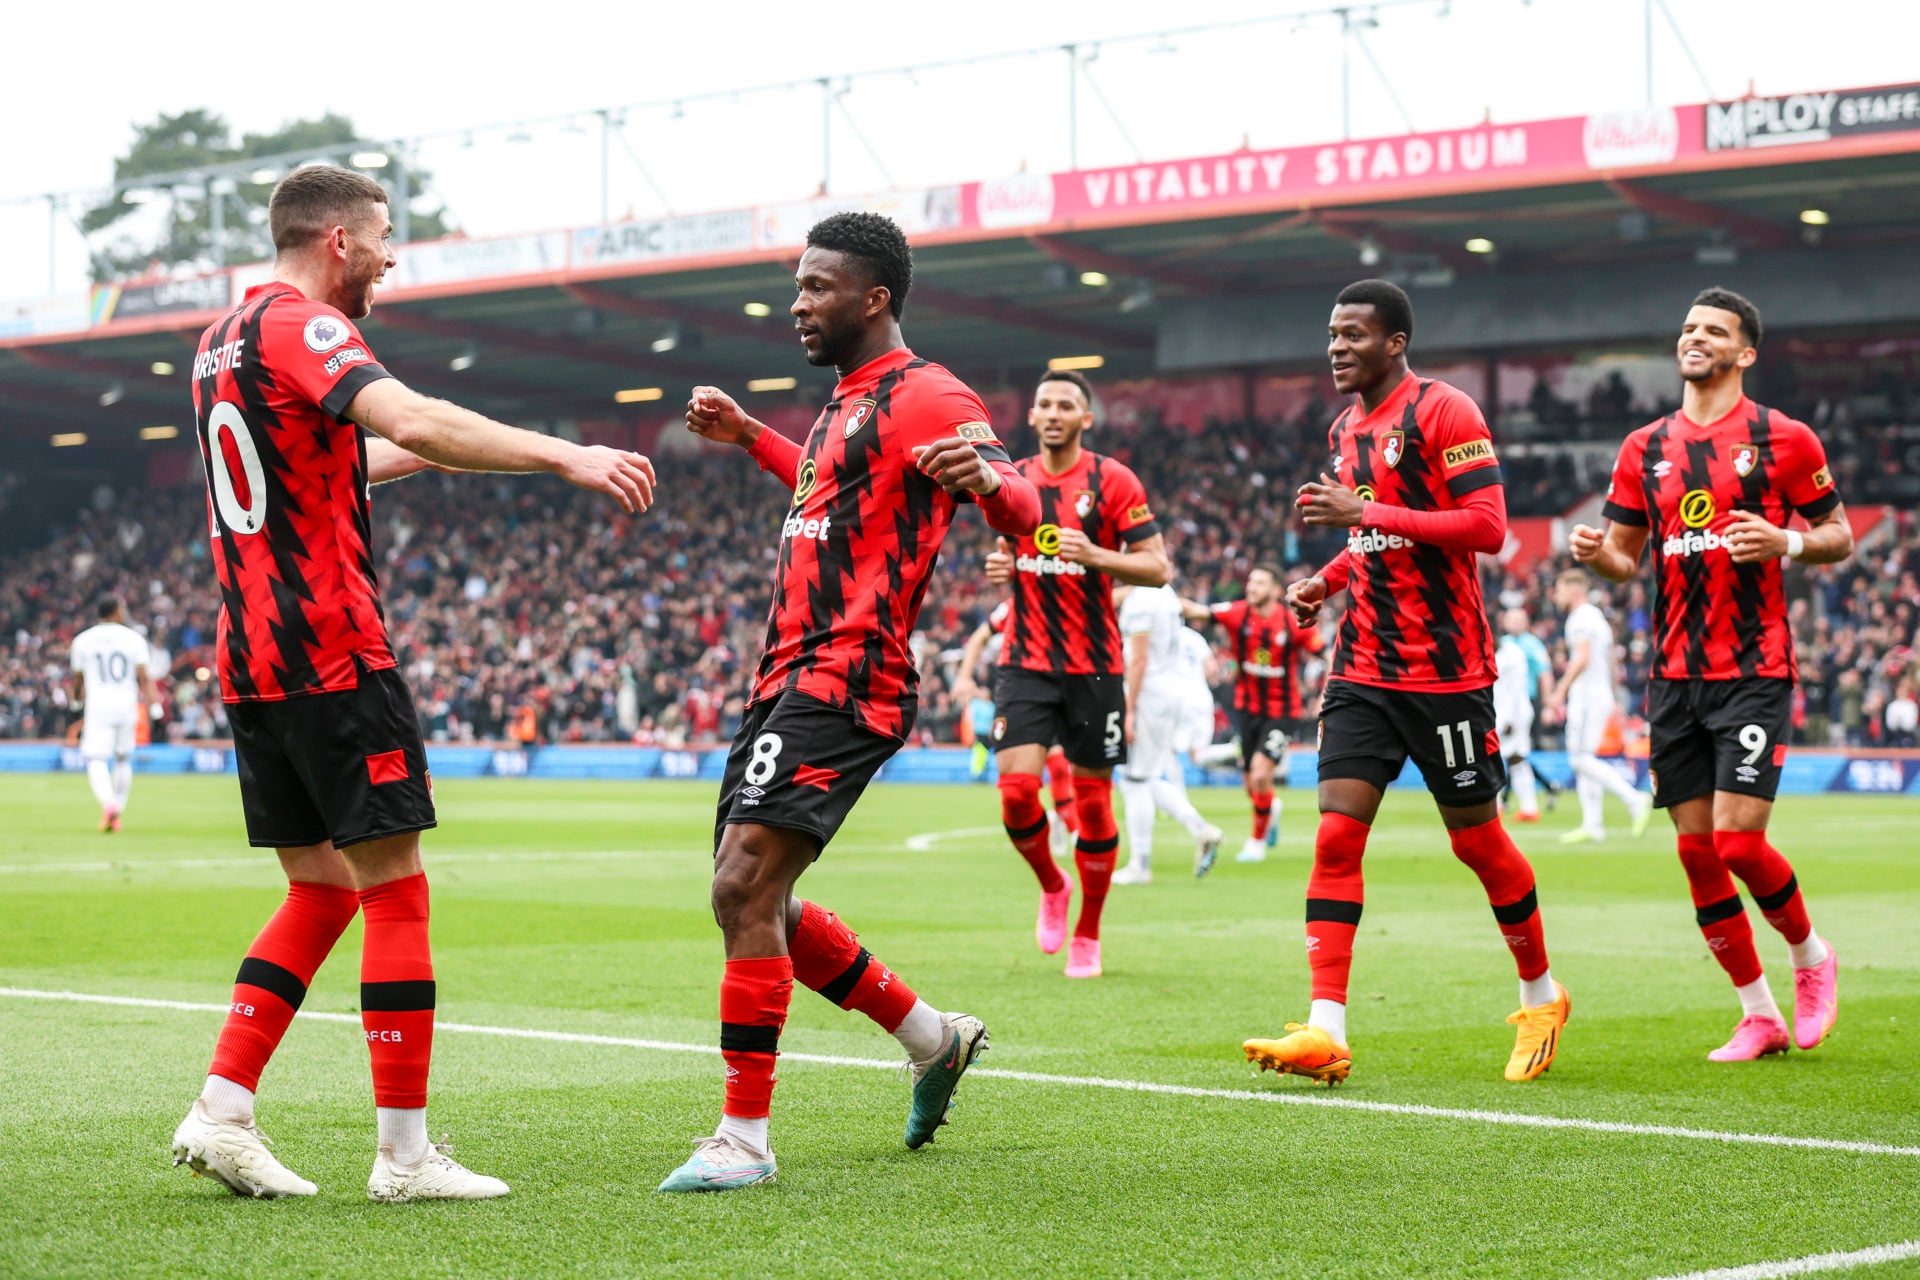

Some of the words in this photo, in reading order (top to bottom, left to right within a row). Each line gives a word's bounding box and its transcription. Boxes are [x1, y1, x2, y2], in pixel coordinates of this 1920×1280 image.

[1706, 92, 1838, 152] MPLOY
[1839, 92, 1920, 126] STAFF
[1084, 152, 1288, 209] VITALITY
[1314, 127, 1529, 186] STADIUM
[598, 223, 664, 257] ARC
[192, 339, 246, 382] HRISTIE
[326, 357, 337, 369] No
[335, 349, 363, 360] room
[195, 401, 267, 537] 0
[781, 510, 831, 543] fabet
[1663, 528, 1741, 557] dafabe
[96, 650, 128, 685] 10
[1104, 710, 1122, 746] 5
[1436, 719, 1476, 769] 11
[1738, 724, 1767, 765] 9
[745, 733, 783, 786] 8
[878, 967, 898, 992] AF
[229, 1002, 255, 1017] FCB
